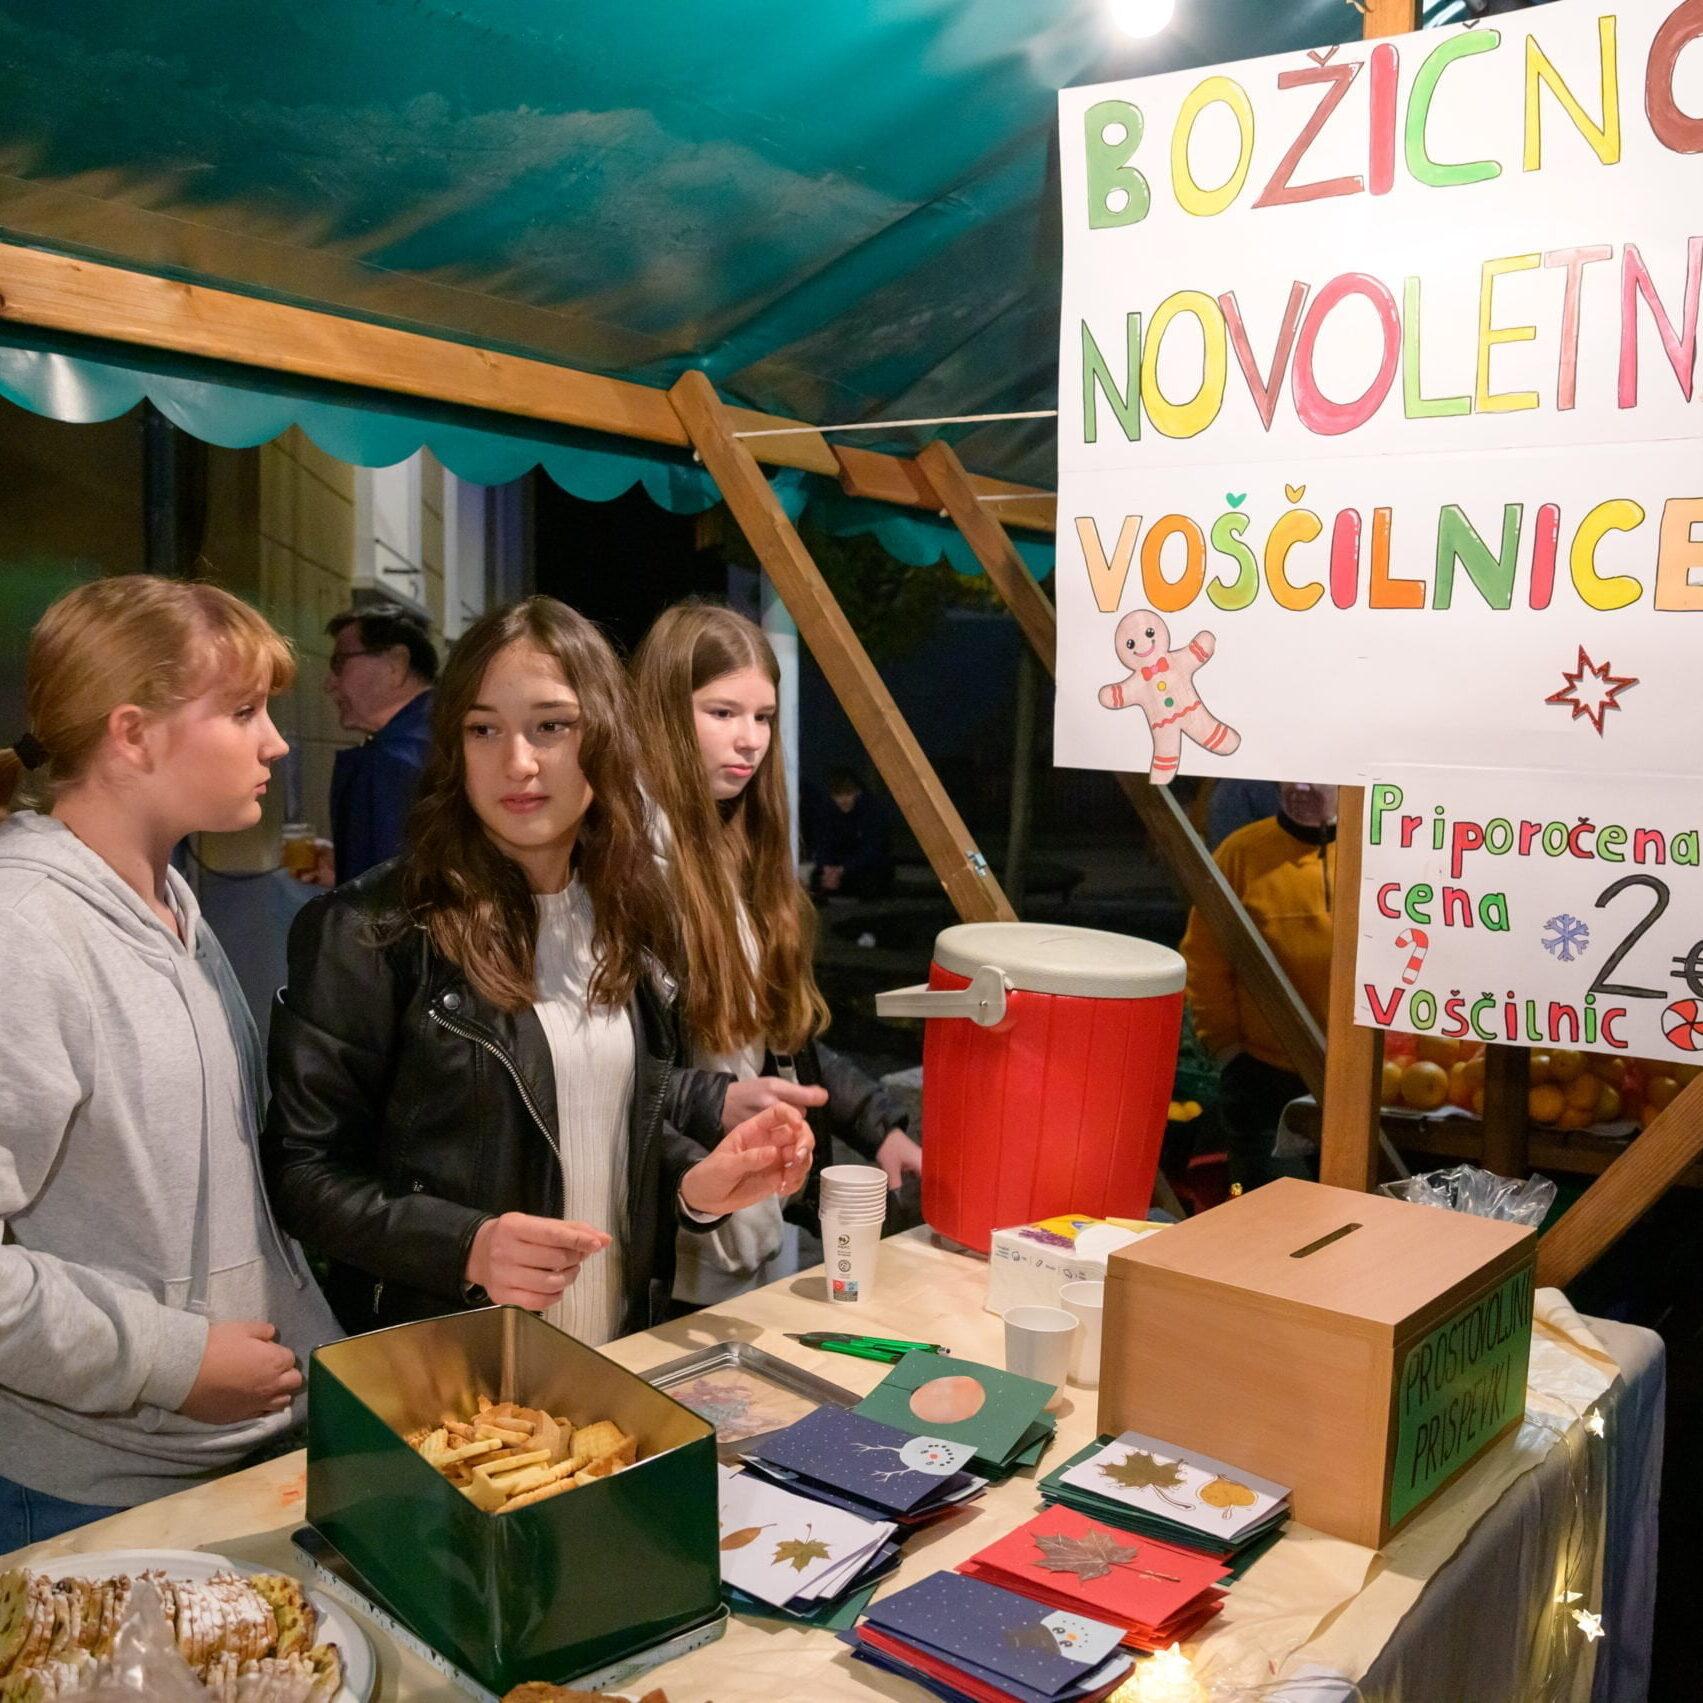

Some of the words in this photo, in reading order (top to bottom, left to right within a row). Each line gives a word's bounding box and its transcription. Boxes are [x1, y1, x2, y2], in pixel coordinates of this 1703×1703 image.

[1074, 484, 1703, 612] VOŠČILNICE
[1370, 784, 1700, 878] Priporočena
[1377, 883, 1510, 931] cena
[1364, 984, 1629, 1048] voščilnic
[1407, 1270, 1531, 1416] PROSTOVOLJNI
[1411, 1354, 1511, 1489] PRISPEVKI
